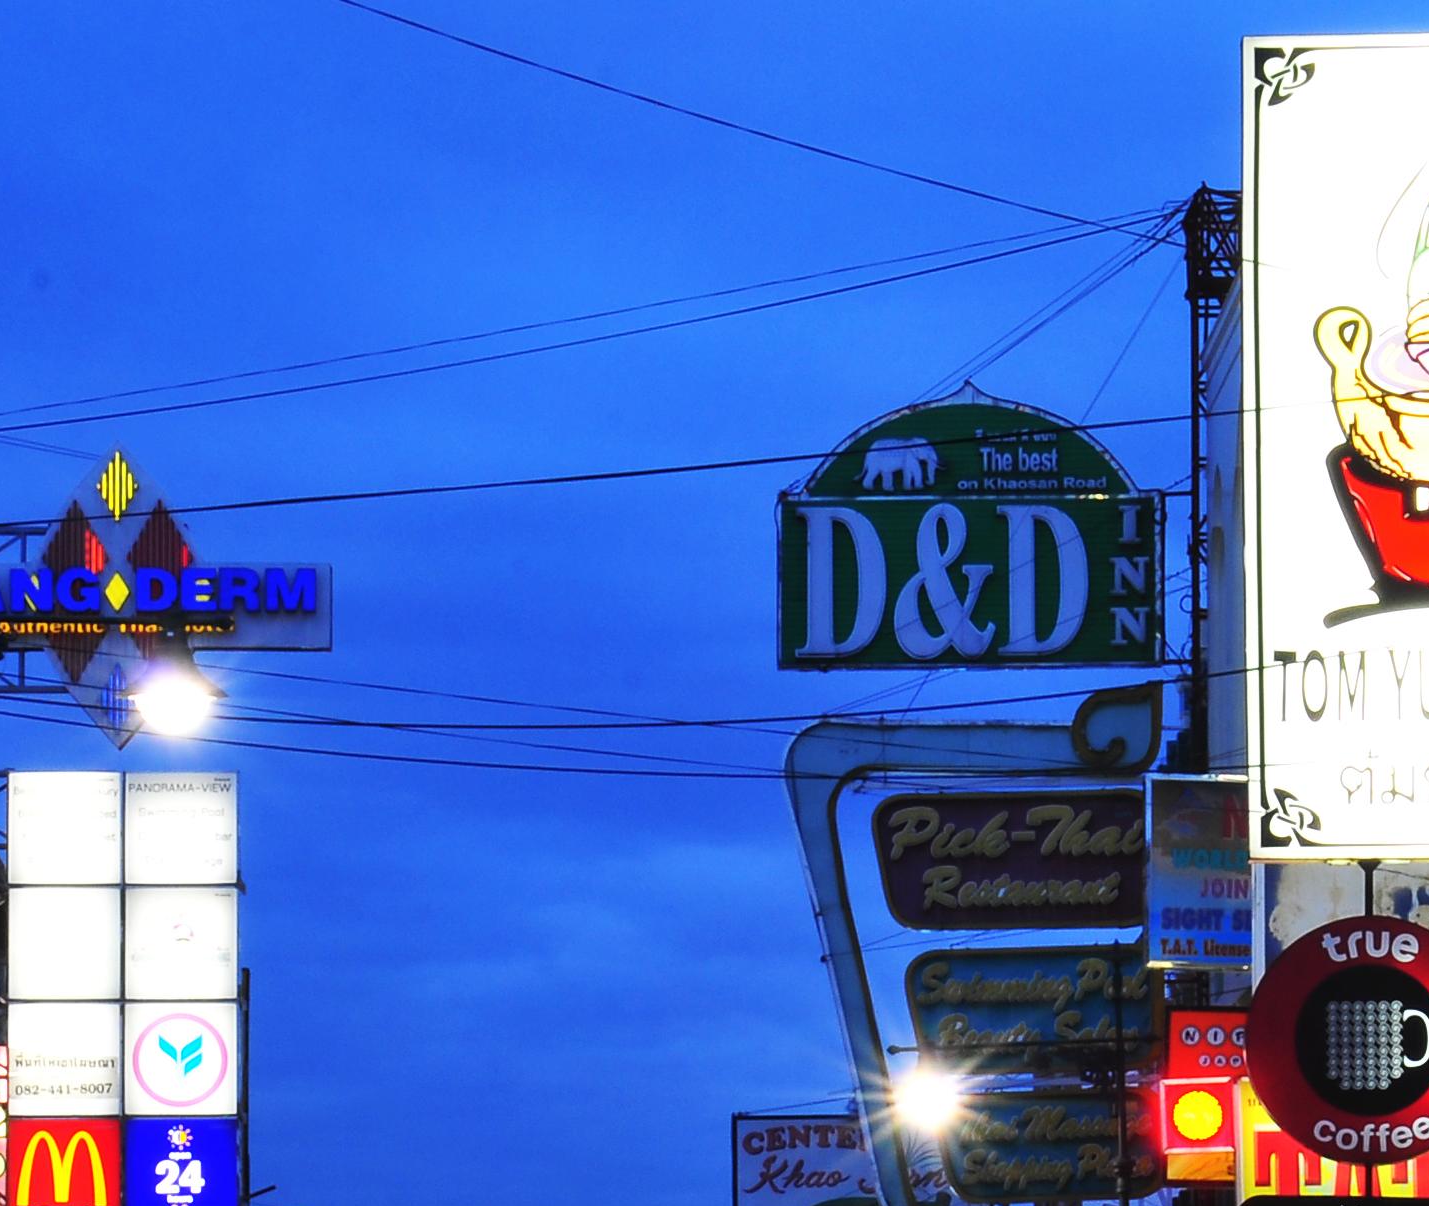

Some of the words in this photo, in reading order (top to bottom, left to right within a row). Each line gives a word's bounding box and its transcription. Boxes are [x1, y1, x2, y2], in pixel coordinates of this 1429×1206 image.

[979, 447, 1013, 472] The
[1018, 447, 1059, 472] best
[957, 478, 979, 491] on
[983, 476, 1059, 491] Khaosan
[1063, 474, 1108, 490] Road
[795, 502, 1090, 661] D&D
[1109, 504, 1151, 646] INN
[1273, 649, 1367, 722] TOM
[887, 803, 1146, 862] Pick-Thai
[922, 864, 1122, 909] Restaurant
[1321, 930, 1421, 963] true
[155, 1159, 206, 1195] 24
[742, 1153, 851, 1195] Khao
